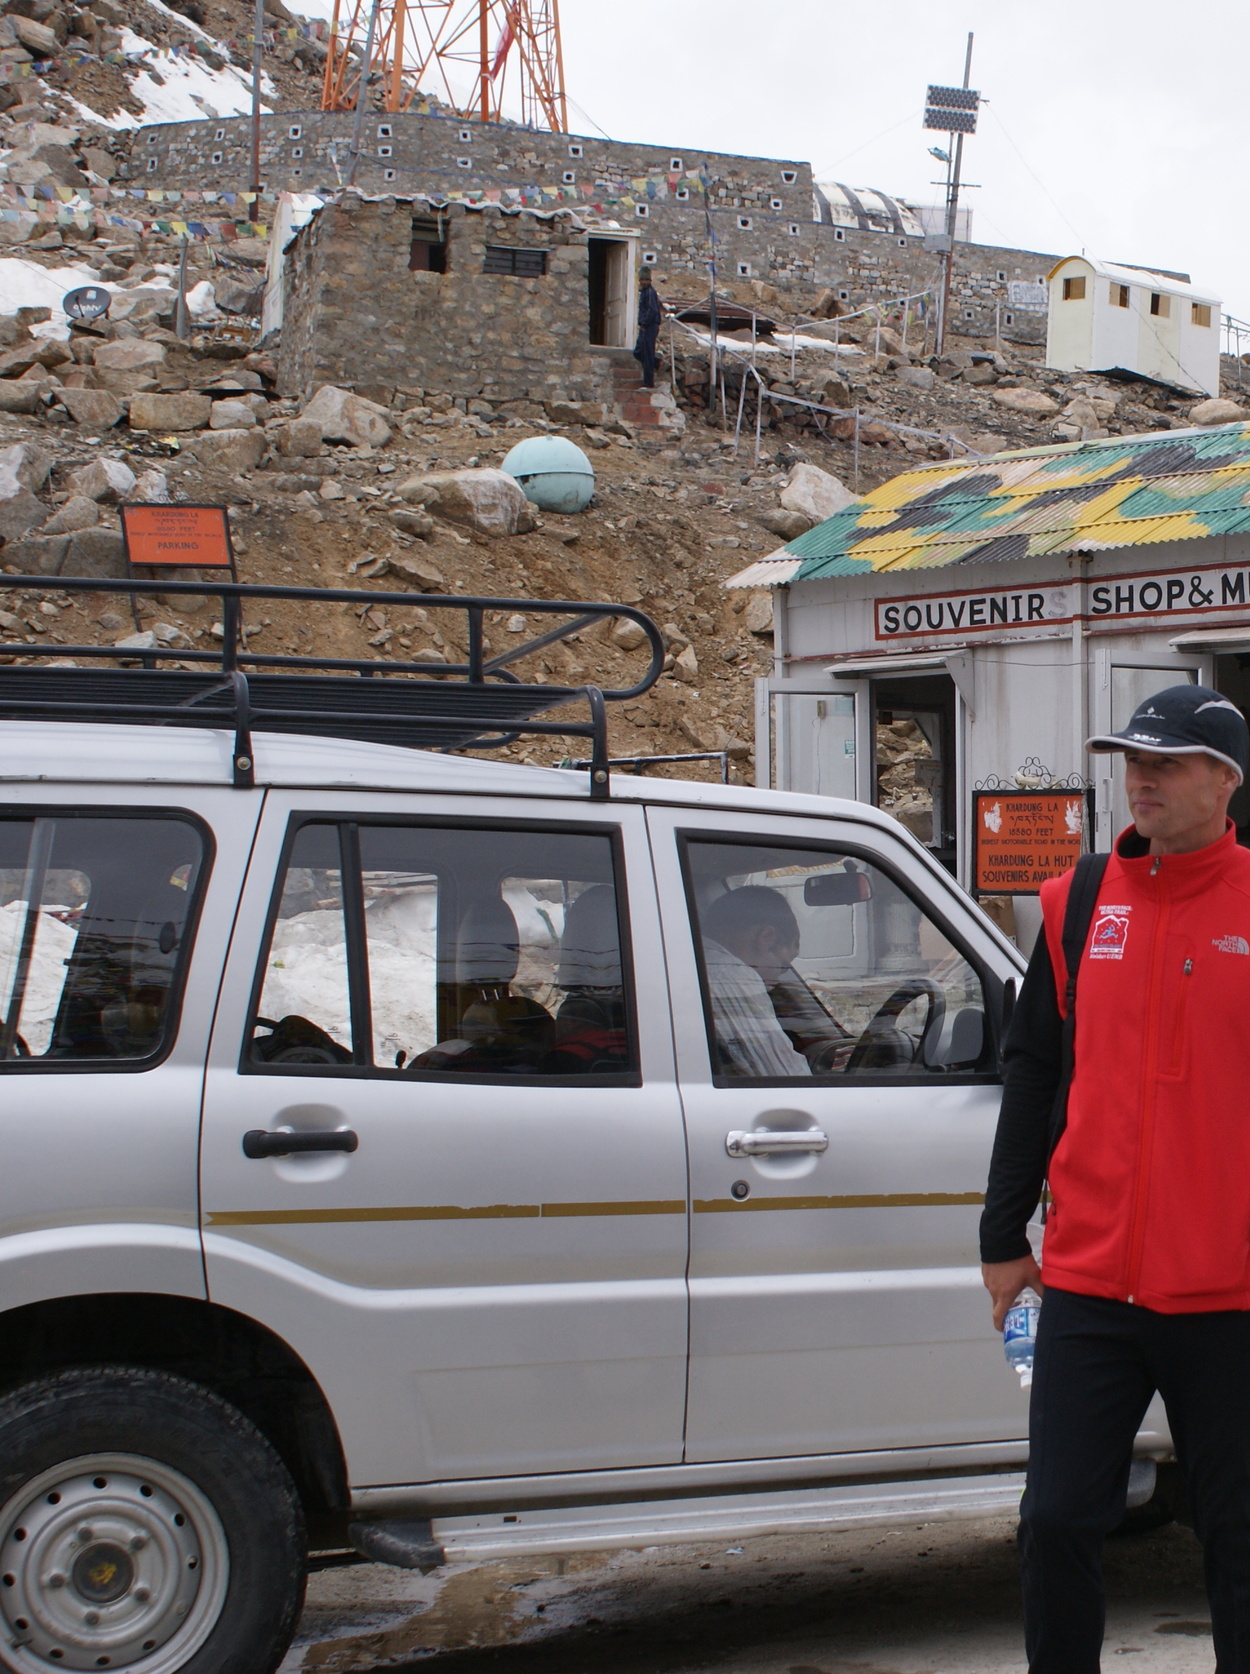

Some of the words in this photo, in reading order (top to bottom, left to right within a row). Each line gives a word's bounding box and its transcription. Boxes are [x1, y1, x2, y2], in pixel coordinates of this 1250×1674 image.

[157, 541, 199, 549] PARKING
[1005, 802, 1043, 812] KHARDUNG
[1047, 802, 1059, 812] LA
[1036, 828, 1054, 836] FEET
[988, 854, 1034, 867] KHARDUNG
[1038, 854, 1050, 867] LA
[1054, 855, 1074, 867] HUT
[982, 870, 1030, 883] SOUVENIRS
[1211, 939, 1238, 948] NORTH
[1218, 944, 1238, 954] FACE
